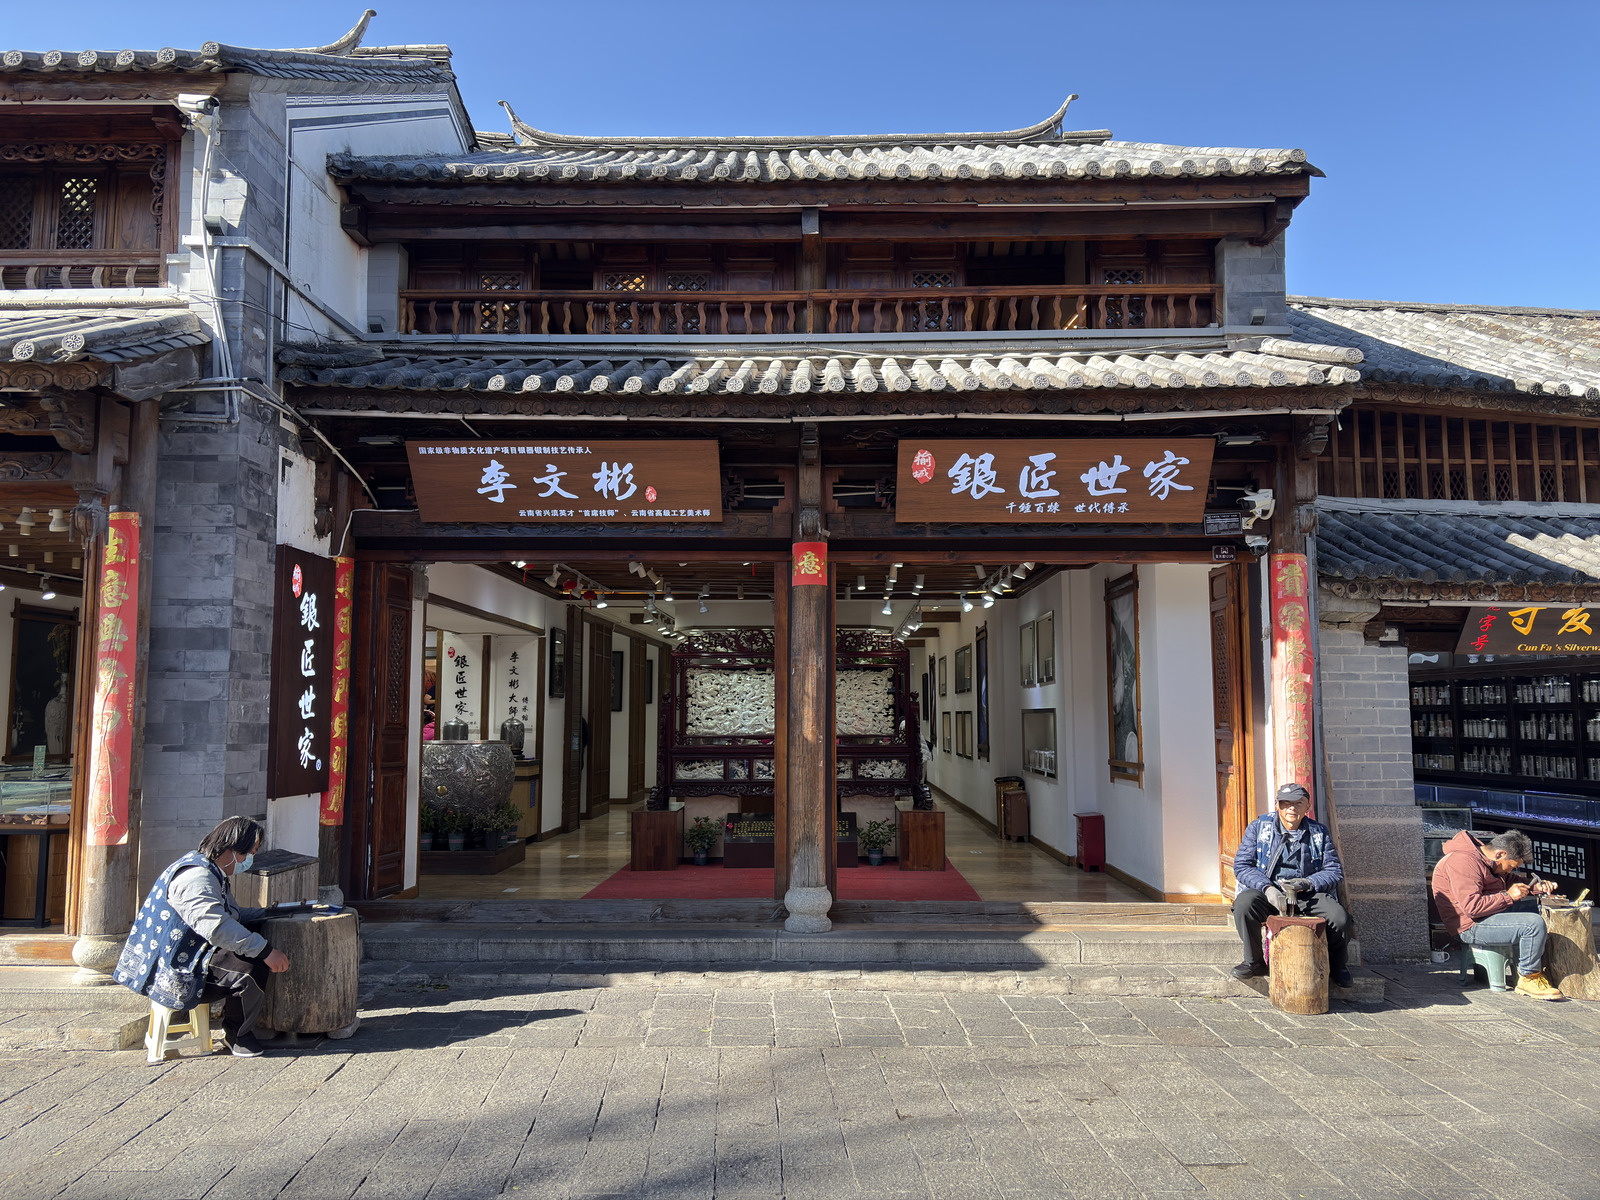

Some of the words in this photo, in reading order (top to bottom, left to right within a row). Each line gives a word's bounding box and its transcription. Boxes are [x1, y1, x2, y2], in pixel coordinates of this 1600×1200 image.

[477, 459, 637, 503] 李文彬
[948, 451, 1194, 500] 銀匠世家
[1470, 606, 1501, 651] 字号
[1517, 643, 1538, 652] Cun
[1540, 643, 1553, 652] Fa
[298, 591, 320, 769] 銀匠世家
[454, 655, 469, 715] 銀匠世家
